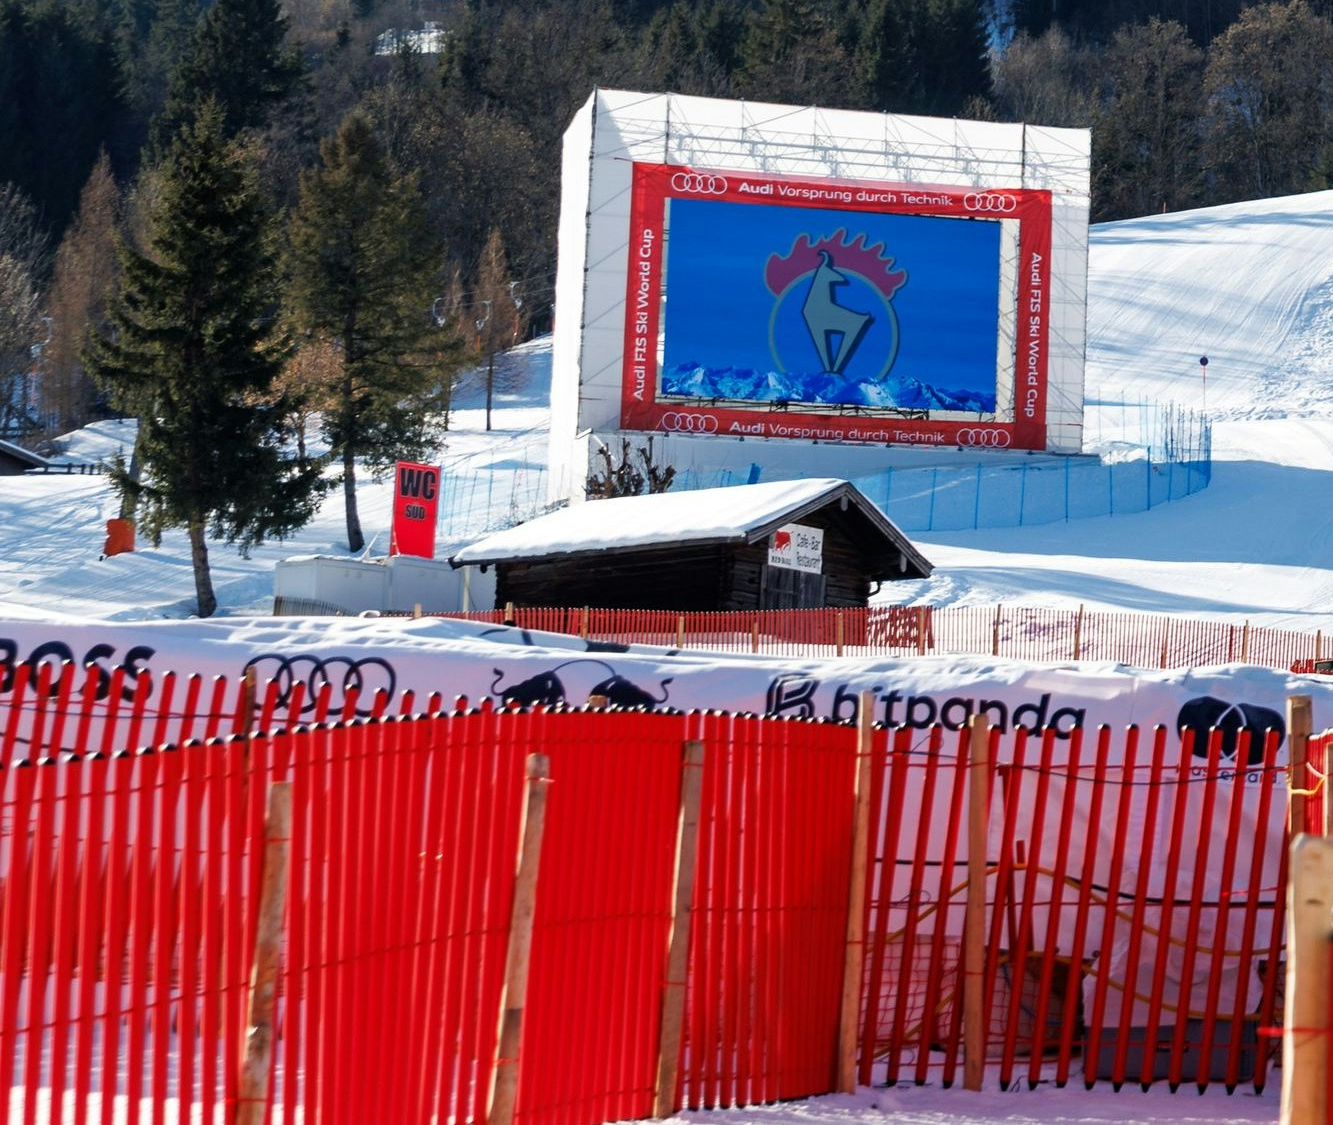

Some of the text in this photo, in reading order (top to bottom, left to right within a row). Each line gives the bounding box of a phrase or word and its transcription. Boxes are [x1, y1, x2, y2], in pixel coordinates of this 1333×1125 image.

[738, 181, 953, 207] Audi Vorsprung durch Technik
[633, 228, 655, 401] Audi FIS Ski World Cup
[1024, 252, 1042, 418] Audi FIS Ski World Cup
[730, 421, 945, 443] Audi Vorsprung durch Technik
[400, 468, 436, 500] WC
